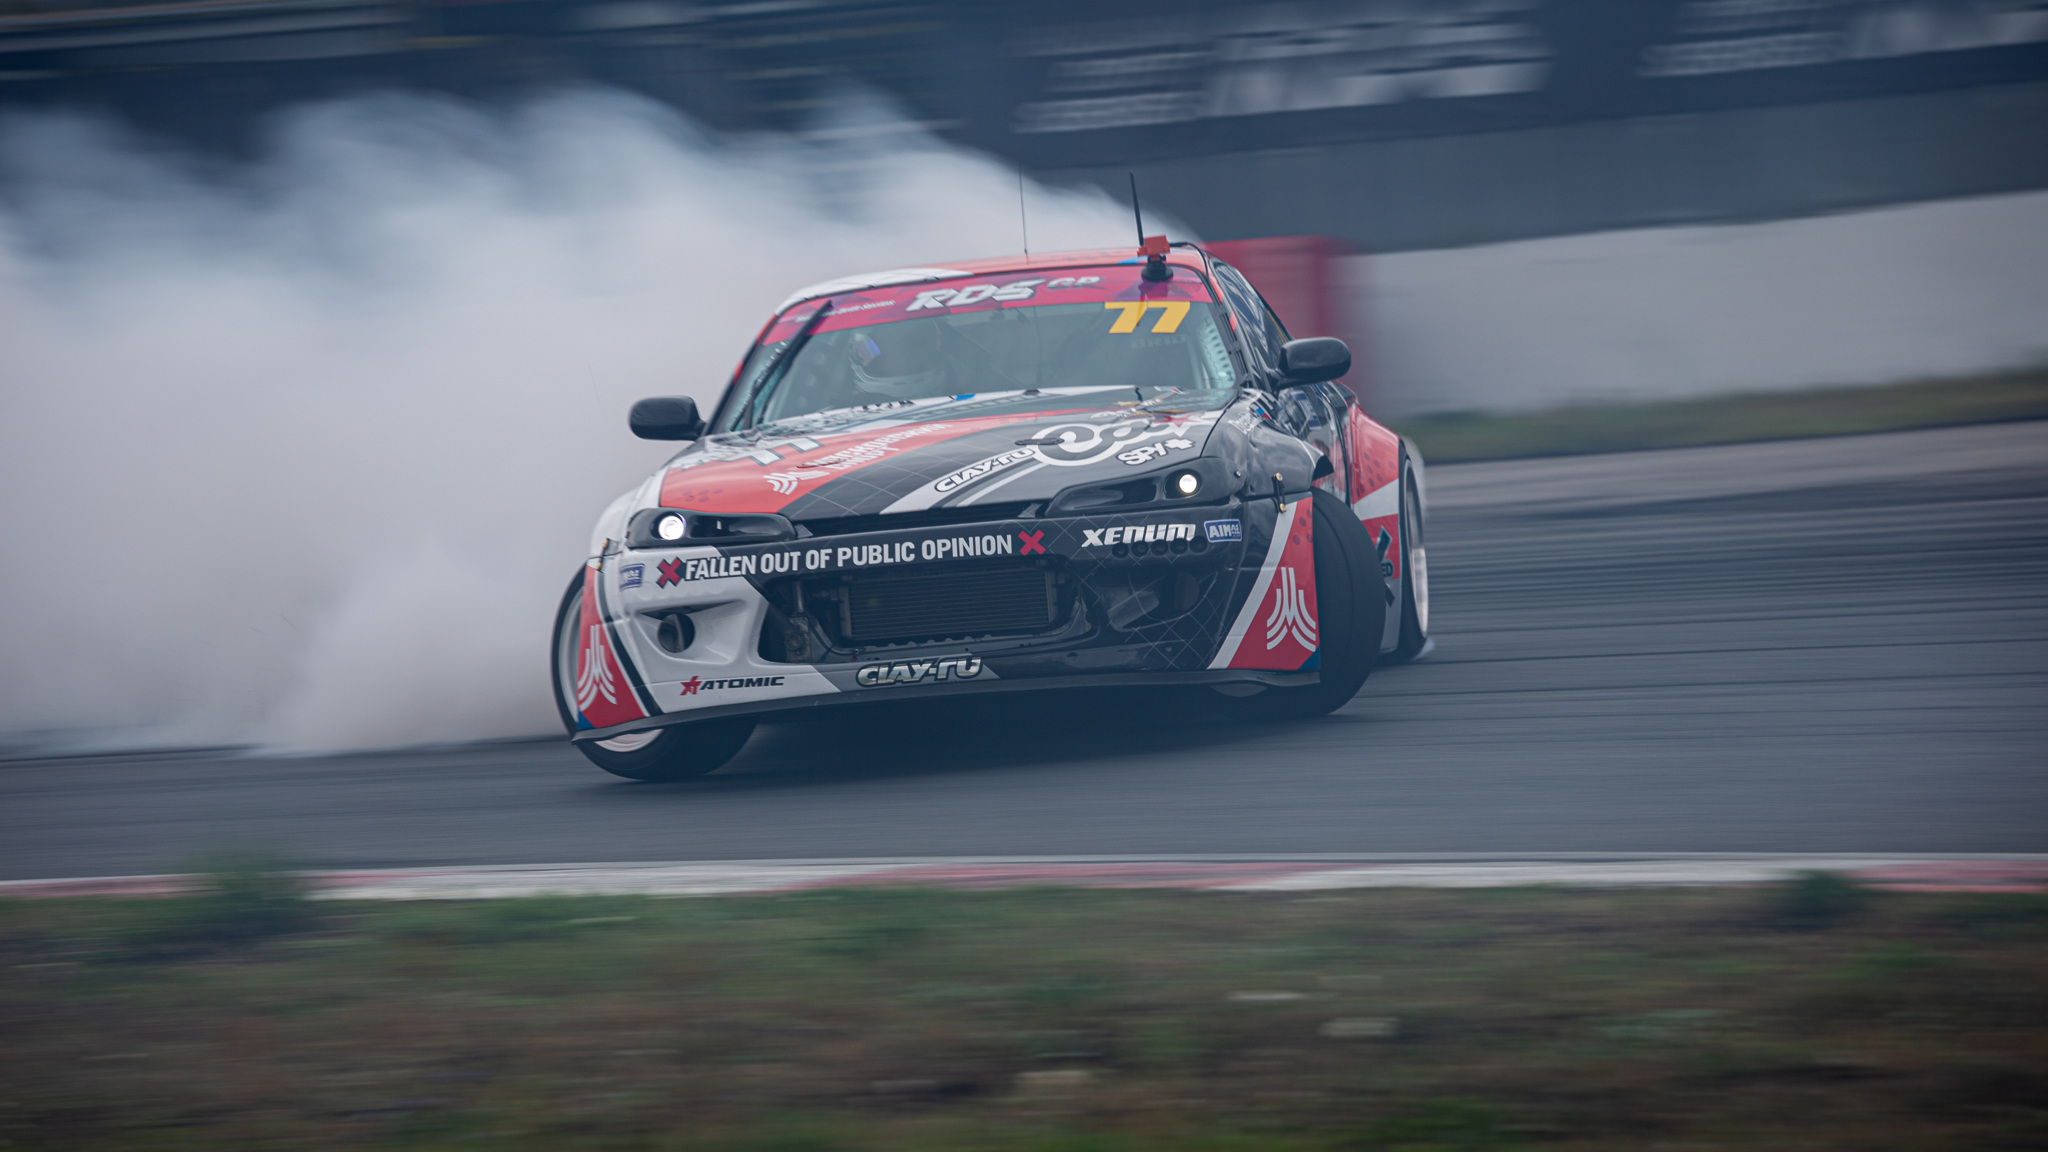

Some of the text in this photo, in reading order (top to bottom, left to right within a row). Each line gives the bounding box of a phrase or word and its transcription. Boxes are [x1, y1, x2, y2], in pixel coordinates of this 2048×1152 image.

[905, 278, 1047, 312] RDS
[1105, 301, 1190, 334] 77
[1081, 523, 1196, 548] XENUM
[685, 534, 1012, 581] FALLEN OUT OF PUBLIC OPINION
[699, 676, 785, 691] ATOMIC
